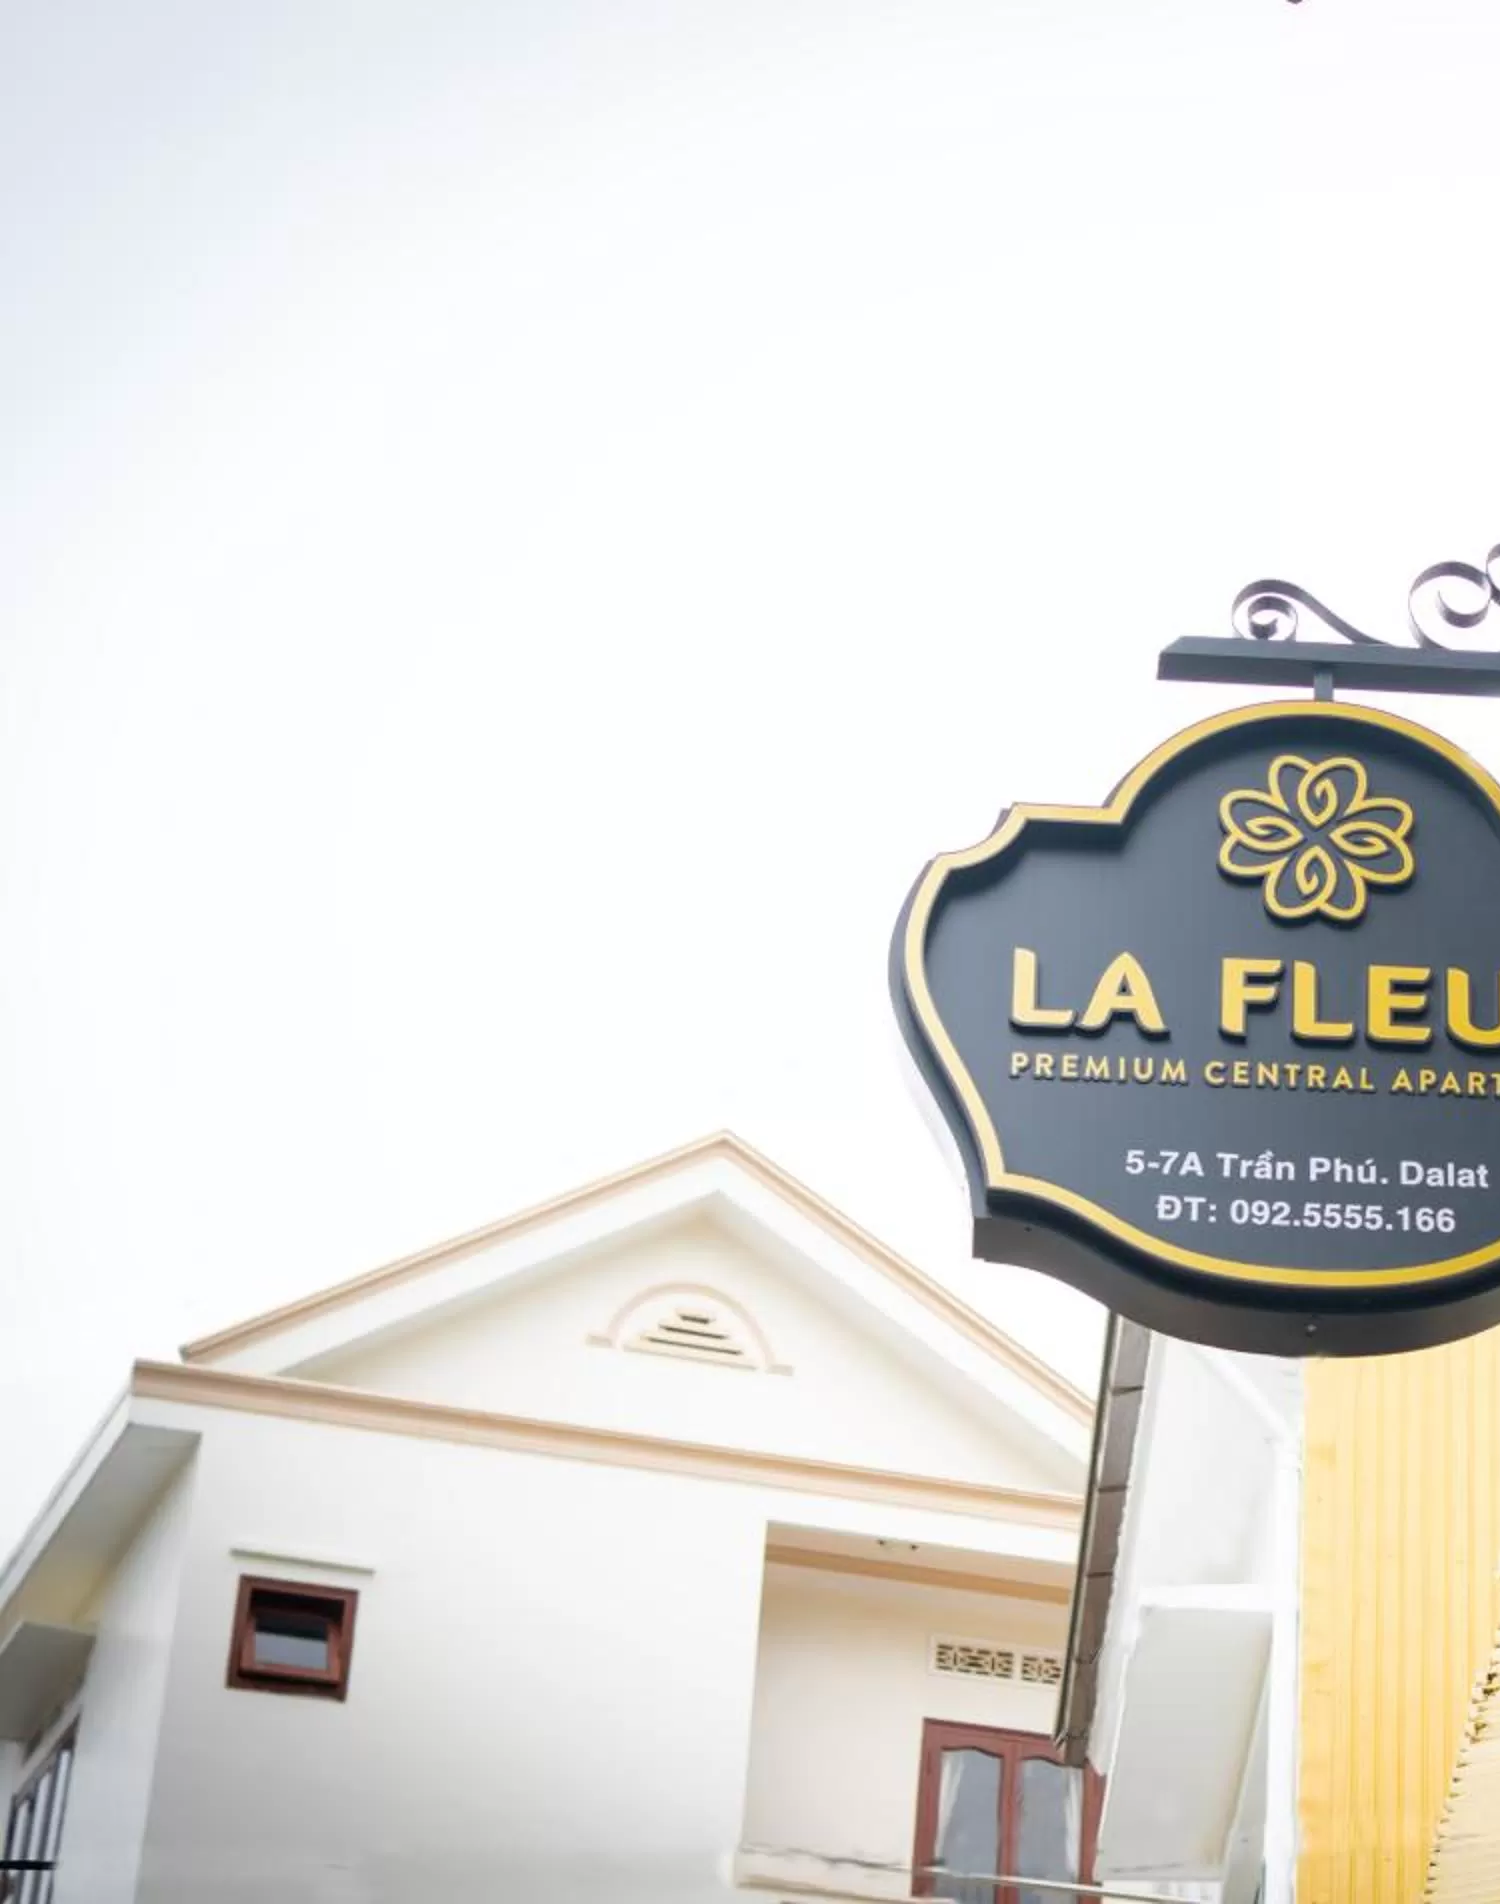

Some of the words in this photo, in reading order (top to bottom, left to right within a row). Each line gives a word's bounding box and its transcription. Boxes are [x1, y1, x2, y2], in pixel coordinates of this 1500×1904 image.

[1011, 946, 1169, 1035] LA
[1010, 1053, 1187, 1083] PREMIUM
[1203, 1060, 1375, 1092] CENTRAL
[1125, 1150, 1204, 1177] 5-7A
[1216, 1150, 1295, 1181] Trần
[1400, 1160, 1489, 1188] Dalat
[1156, 1195, 1217, 1223] ĐT:
[1229, 1199, 1456, 1233] 092.5555.166
